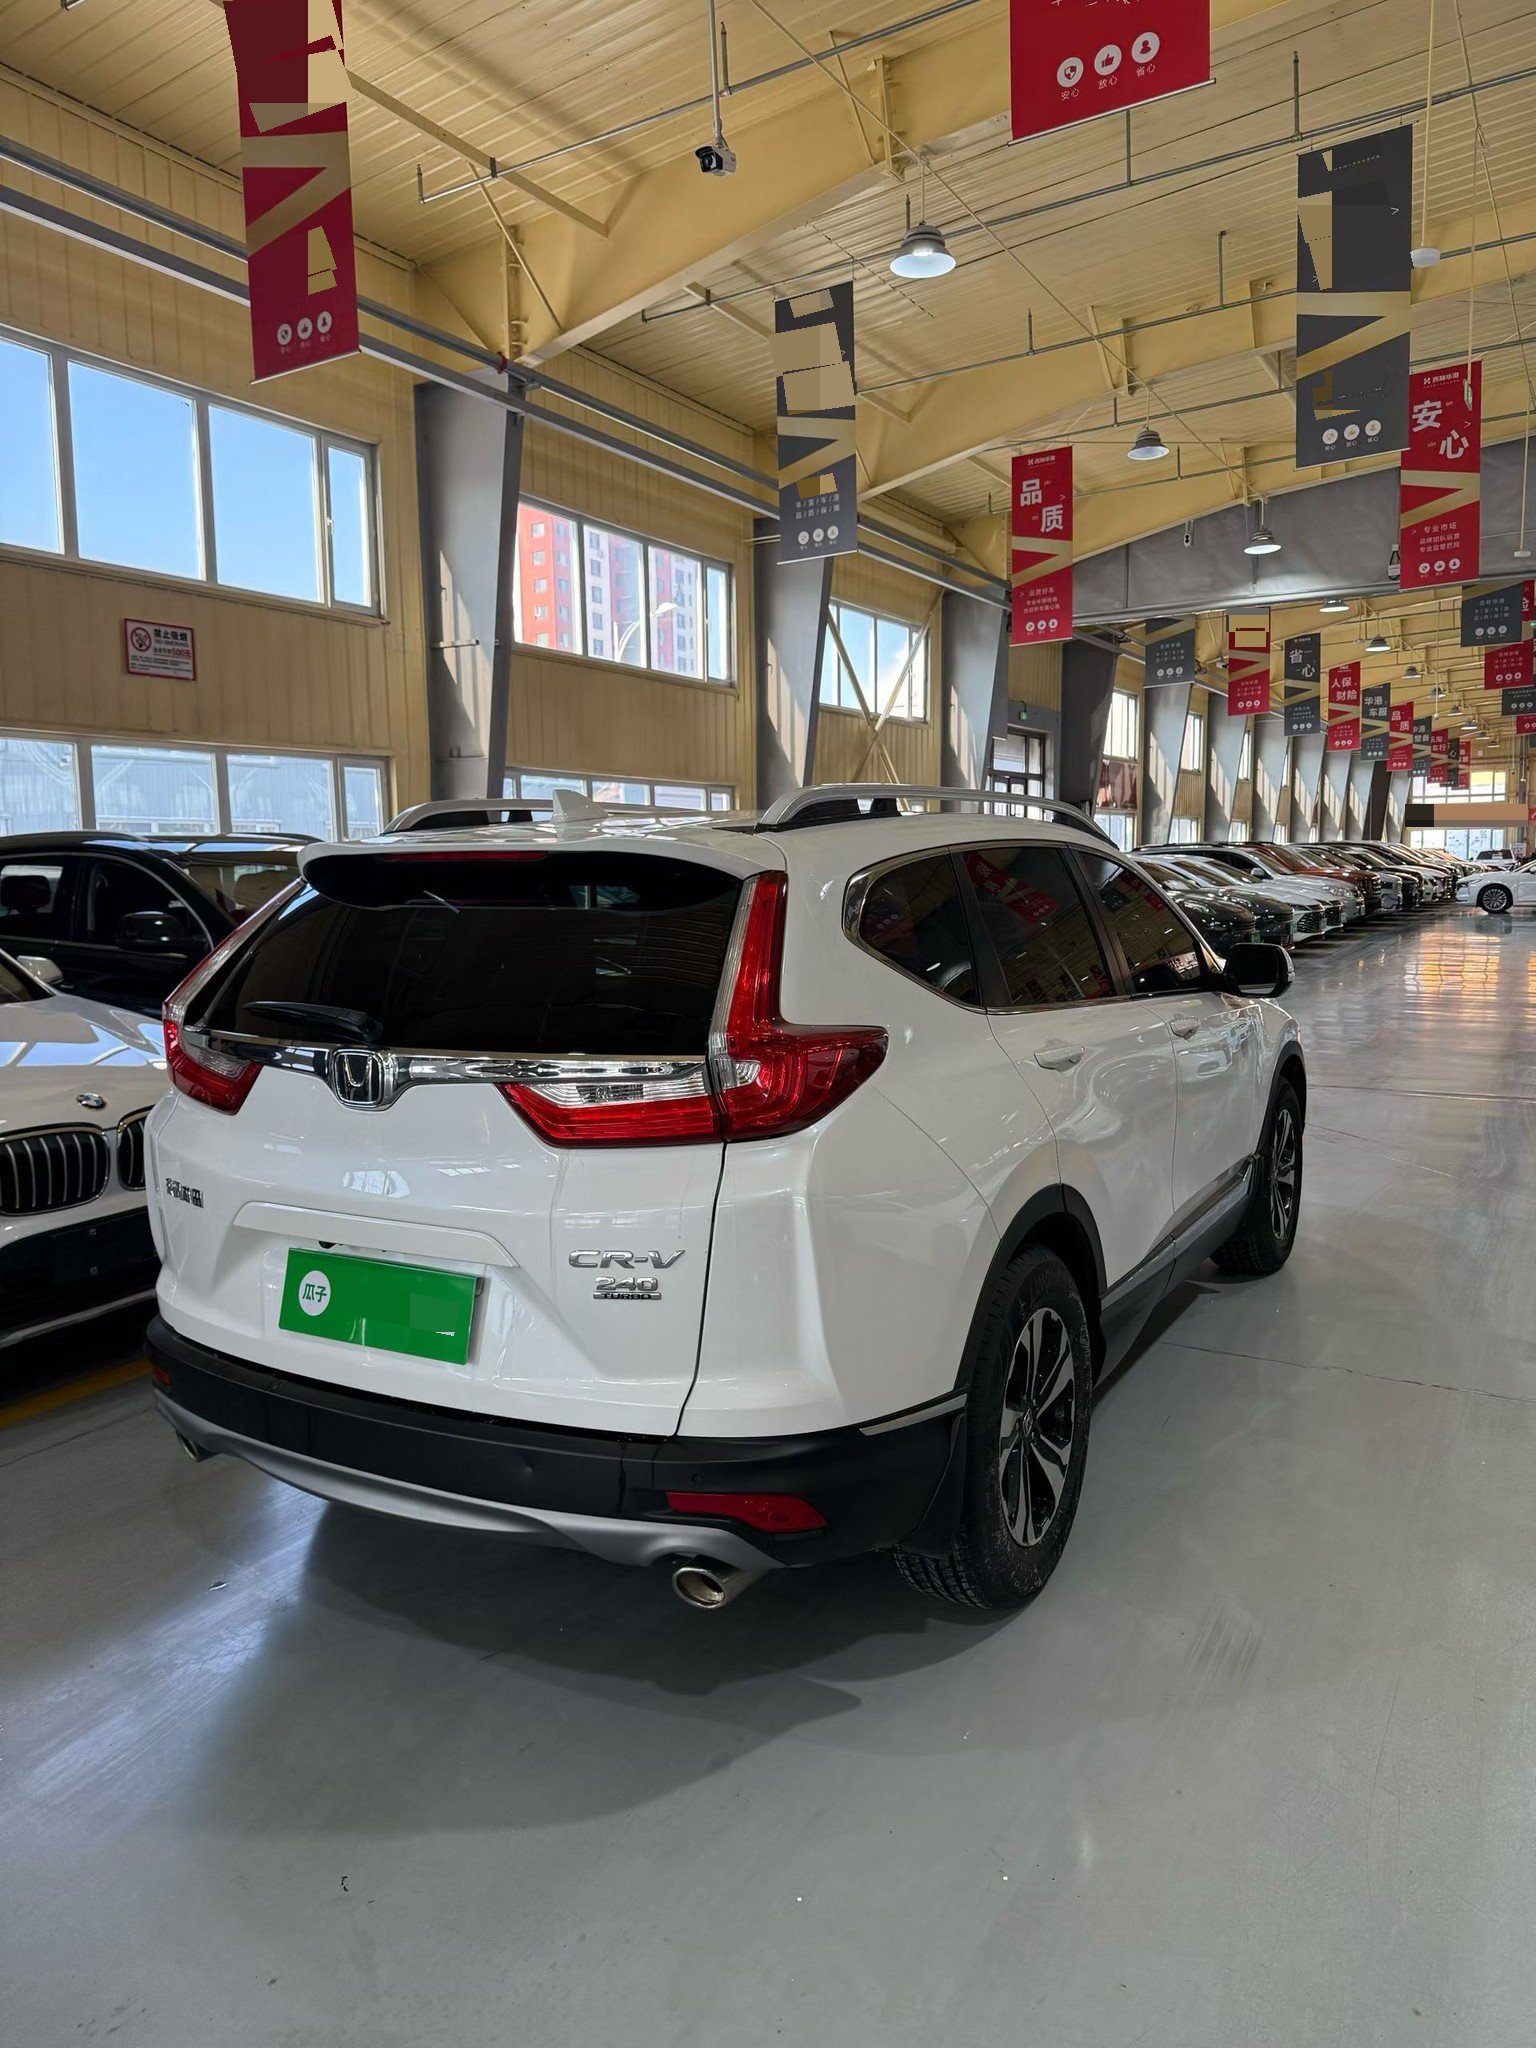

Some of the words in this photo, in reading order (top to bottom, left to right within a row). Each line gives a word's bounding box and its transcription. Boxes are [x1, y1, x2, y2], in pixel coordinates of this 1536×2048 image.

[1061, 88, 1080, 101] 安心
[1098, 75, 1118, 90] 放心
[1411, 400, 1443, 433] 安
[1438, 429, 1470, 460] 心
[1020, 478, 1043, 507] 品
[1040, 503, 1064, 533] 质
[1289, 649, 1304, 664] 省
[1301, 663, 1316, 678] 心
[1331, 677, 1352, 689] 人保
[1336, 689, 1358, 702] 财险
[568, 1249, 686, 1270] CR-V
[302, 1283, 328, 1303] 瓜子
[595, 1276, 658, 1291] 240
